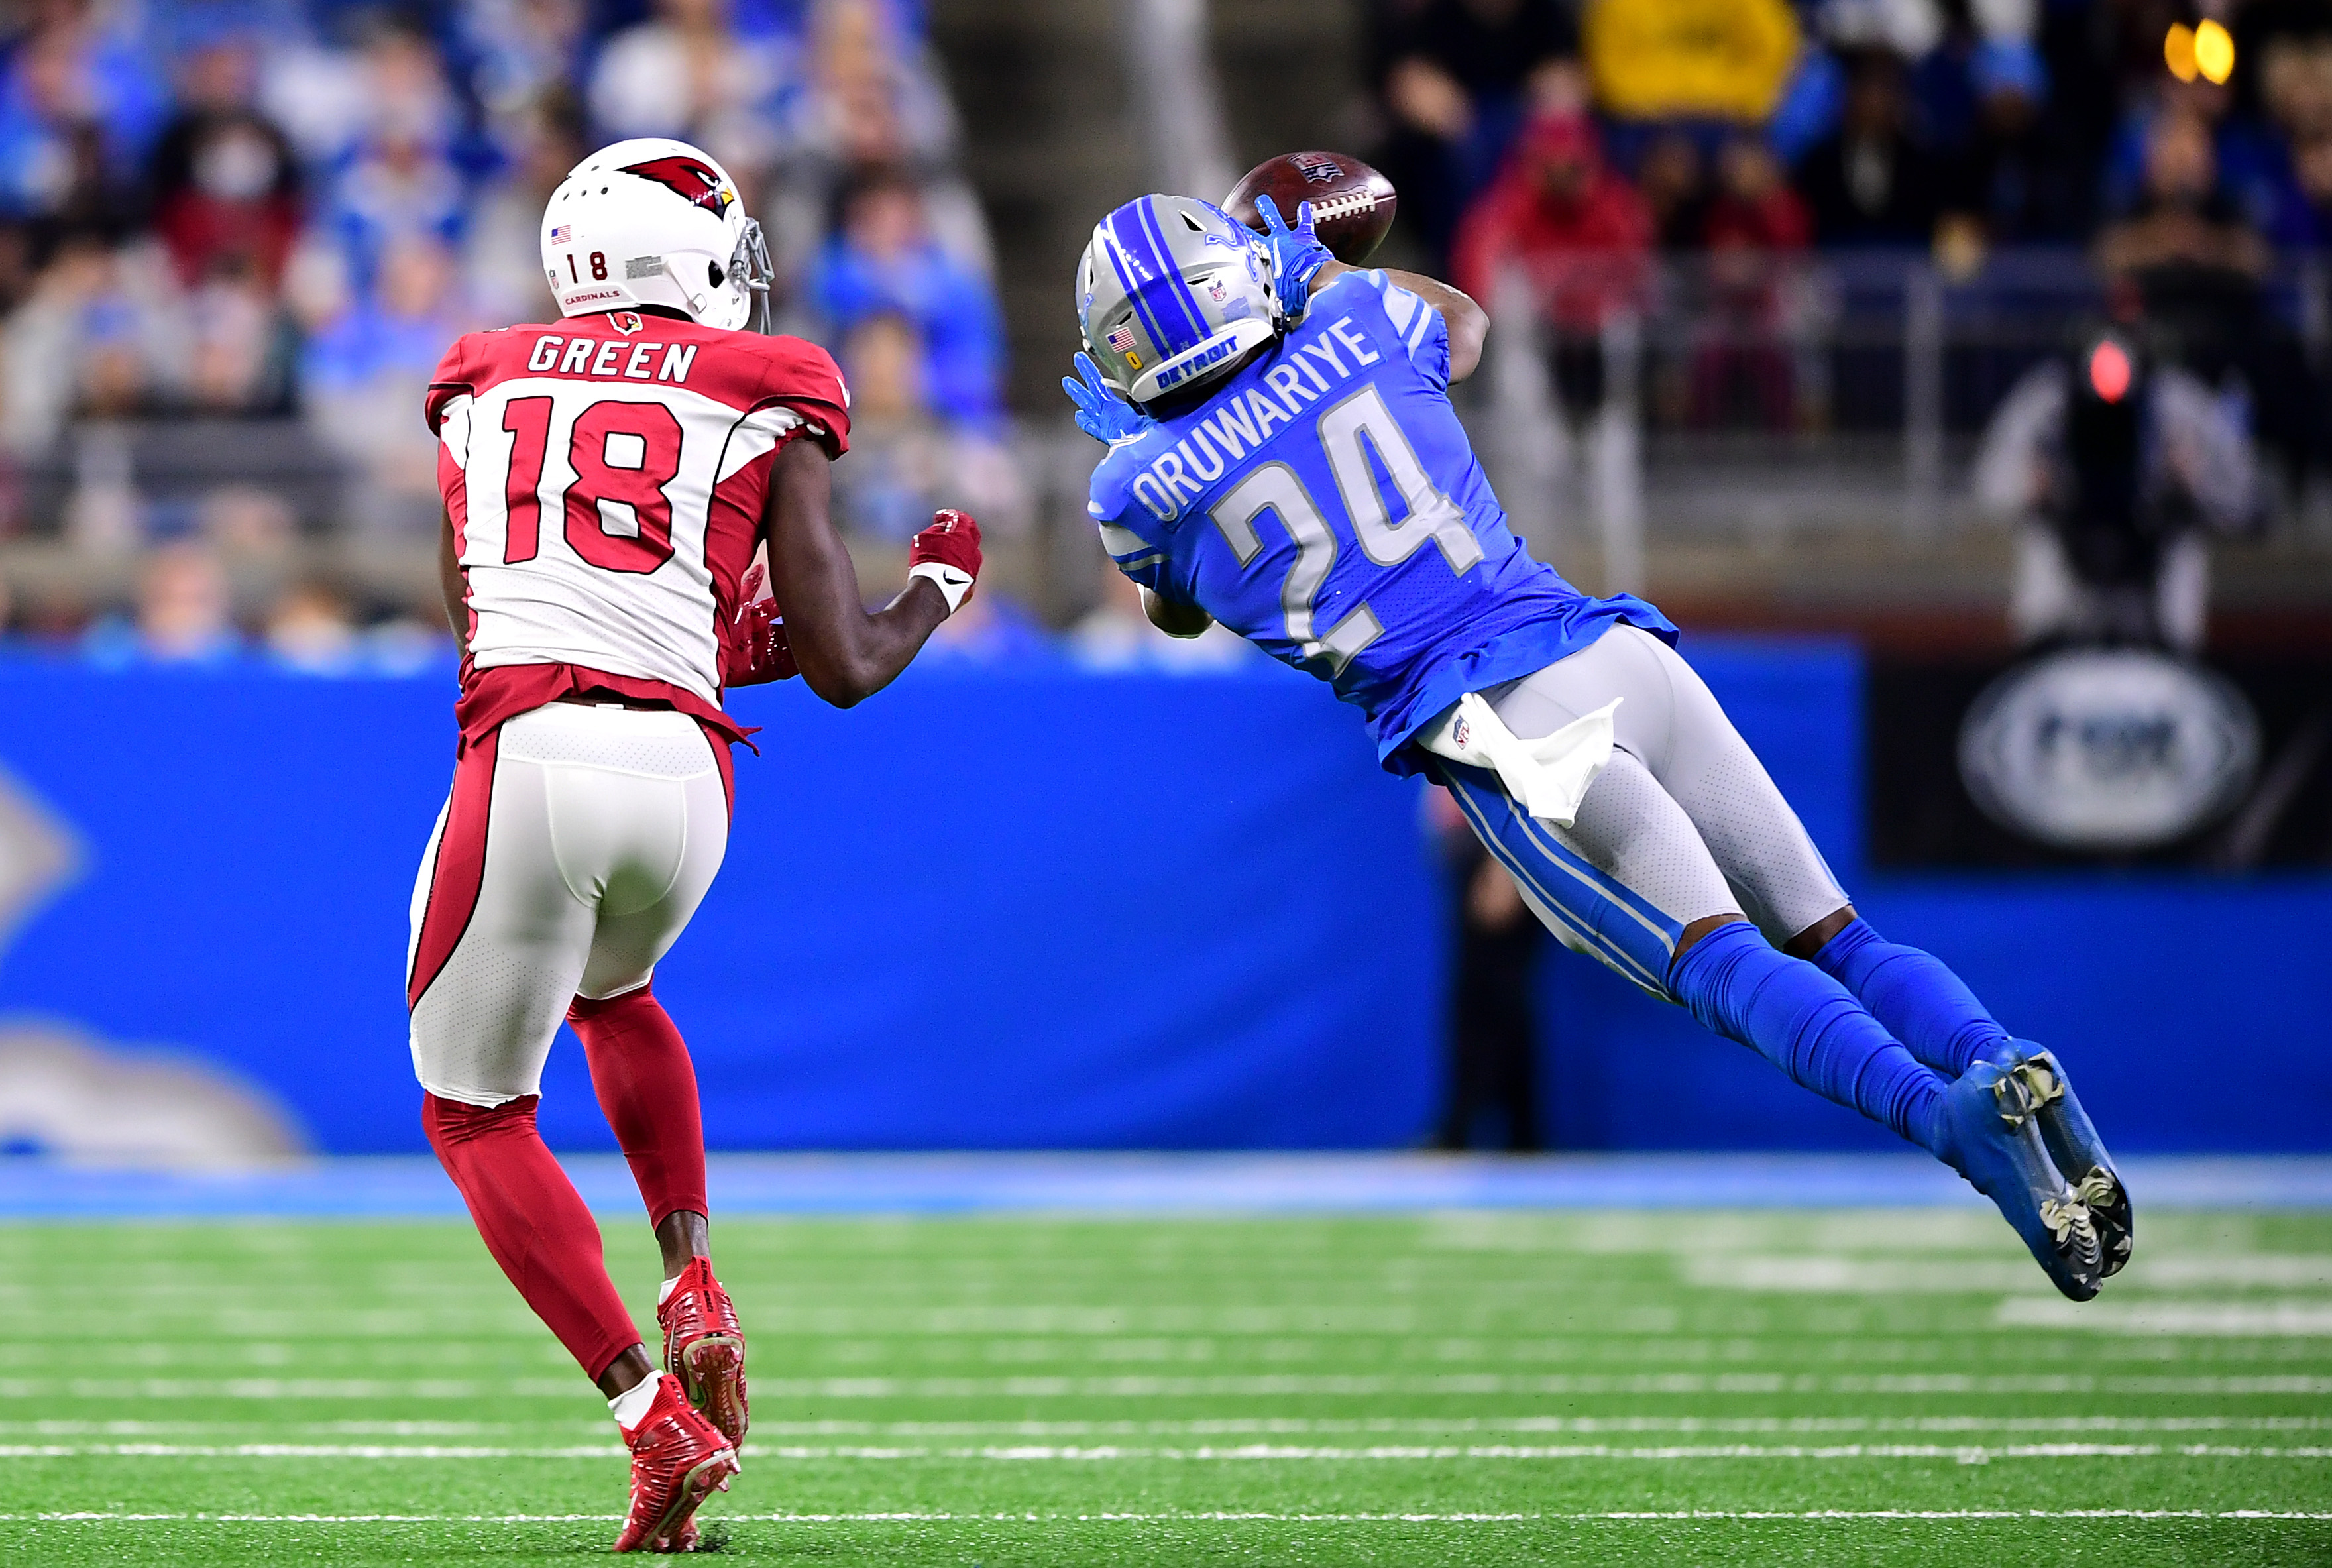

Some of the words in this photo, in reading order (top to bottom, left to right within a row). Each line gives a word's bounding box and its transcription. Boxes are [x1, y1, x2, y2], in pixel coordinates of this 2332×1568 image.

[567, 251, 608, 284] 18
[565, 290, 620, 305] CARDINALS
[528, 335, 698, 383] GREEN
[1156, 335, 1238, 390] DETROIT
[1132, 316, 1381, 522] ORUWARIYE
[502, 396, 684, 575] 18
[1205, 382, 1486, 679] 24
